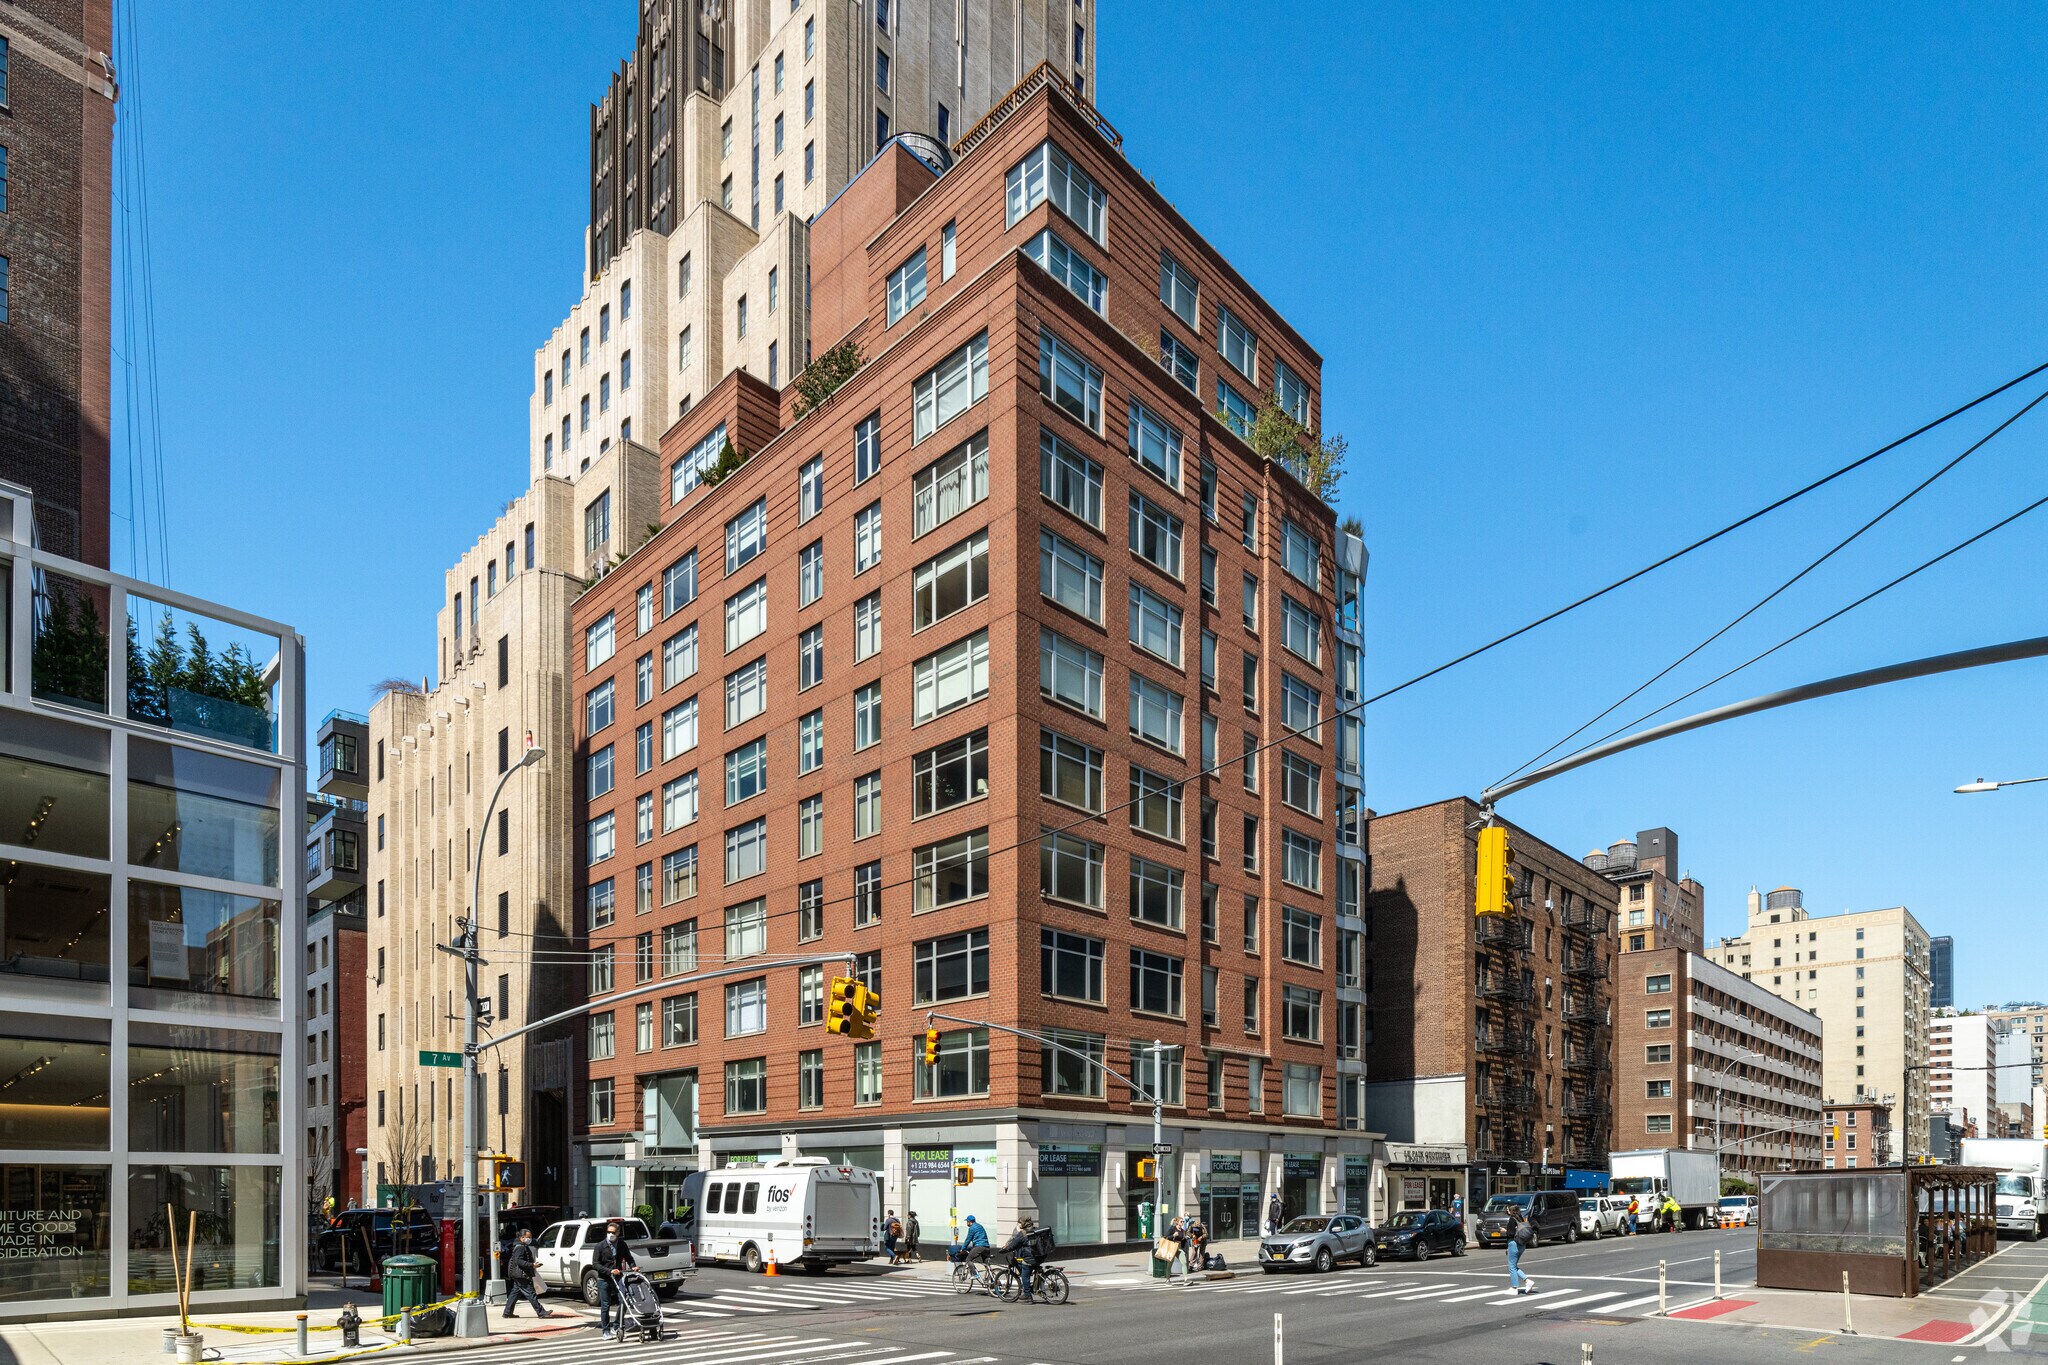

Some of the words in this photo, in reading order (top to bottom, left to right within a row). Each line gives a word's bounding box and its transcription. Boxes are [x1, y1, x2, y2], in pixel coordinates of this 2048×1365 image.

[432, 1053, 438, 1064] 7
[910, 1151, 925, 1160] FOR
[928, 1150, 949, 1160] LEASE
[1050, 1154, 1067, 1162] LEASE
[767, 1185, 790, 1202] fios
[0, 1210, 45, 1220] ITURE
[48, 1209, 82, 1220] AND
[20, 1221, 77, 1233] GOODS
[40, 1234, 55, 1244] IN
